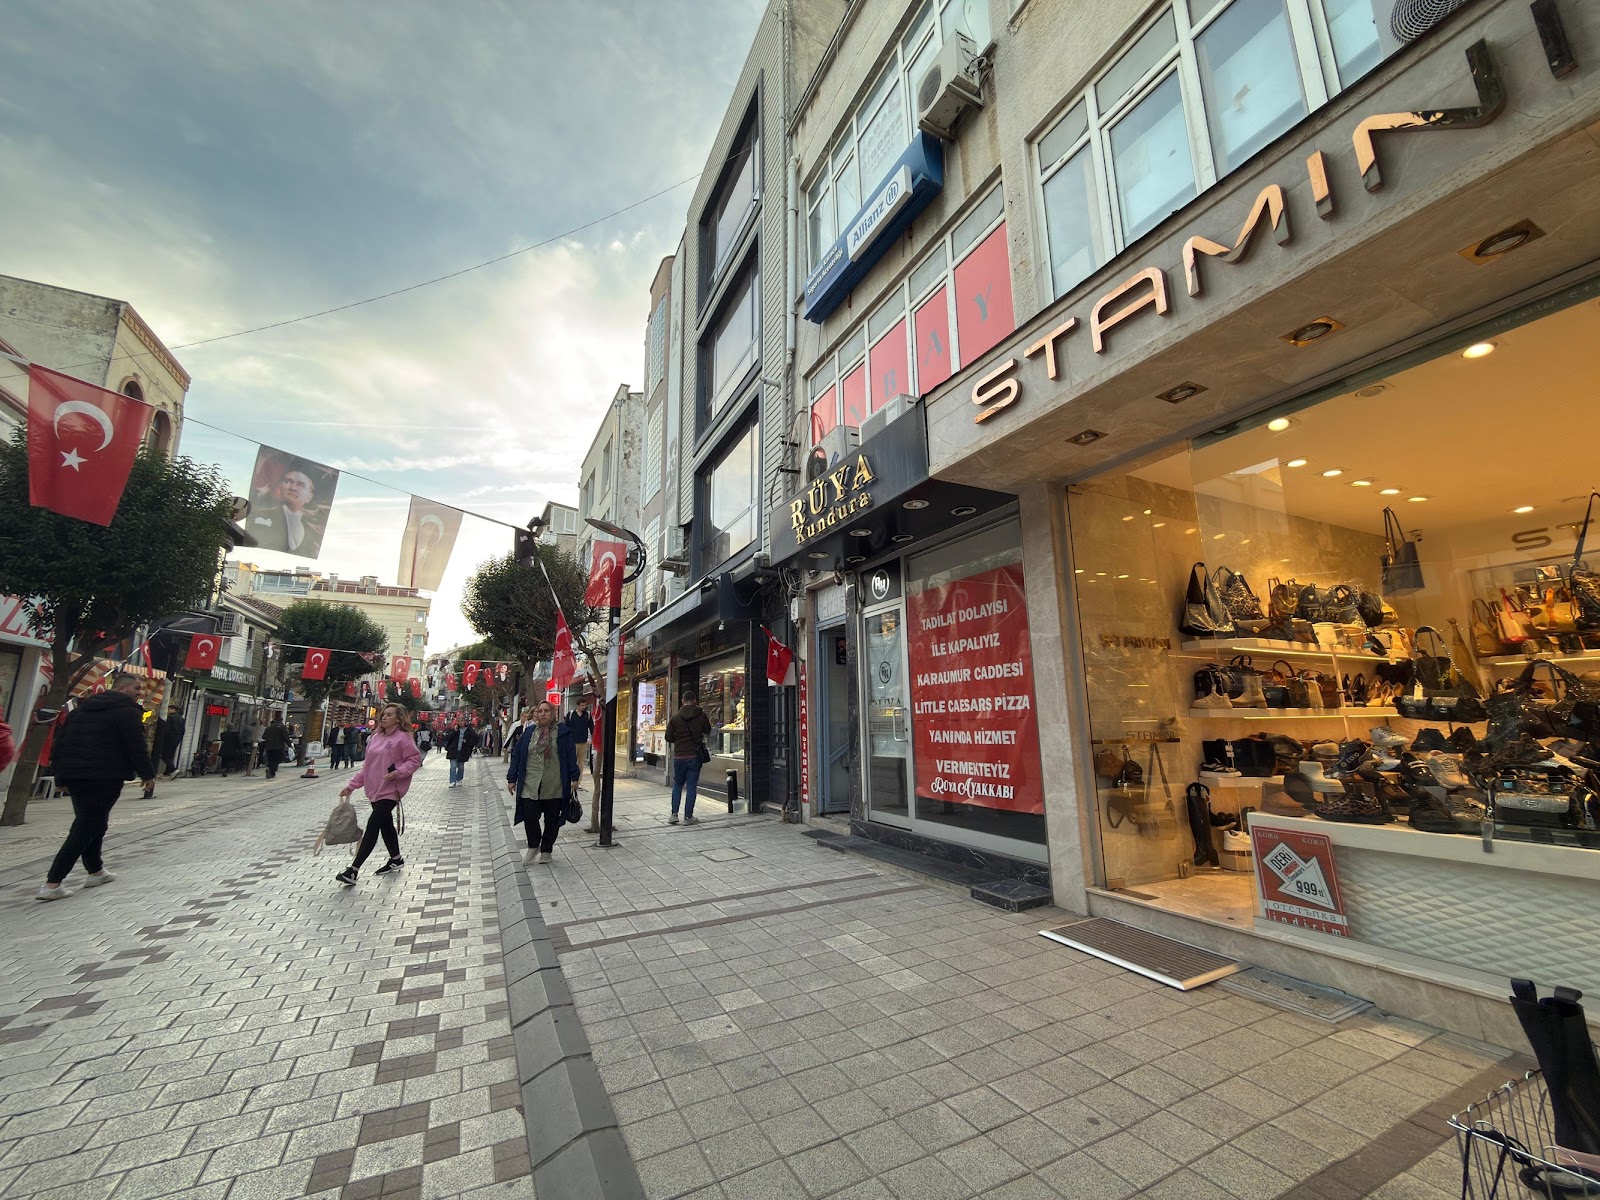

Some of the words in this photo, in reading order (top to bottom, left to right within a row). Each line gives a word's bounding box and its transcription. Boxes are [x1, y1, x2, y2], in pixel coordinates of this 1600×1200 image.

[853, 203, 885, 248] Allianz
[971, 1, 1578, 424] STAMINI
[789, 453, 876, 530] RÜYA
[795, 491, 872, 545] Kundura
[921, 612, 957, 631] TADİLAT
[958, 599, 1008, 623] DOLAYISI
[403, 627, 411, 655] BAYRA
[931, 642, 947, 657] İLE
[948, 632, 1000, 655] KAPALIYIZ
[917, 668, 971, 686] KARAUMUR
[973, 658, 1024, 680] CADDESİ
[947, 697, 992, 713] CAESARS
[994, 692, 1030, 711] PİZZA
[929, 730, 972, 744] YANINDA
[974, 727, 1016, 745] HİZMET
[936, 759, 1010, 779] VERMEKTEYİZ
[1295, 880, 1318, 896] 999
[1272, 912, 1342, 936] indirim
